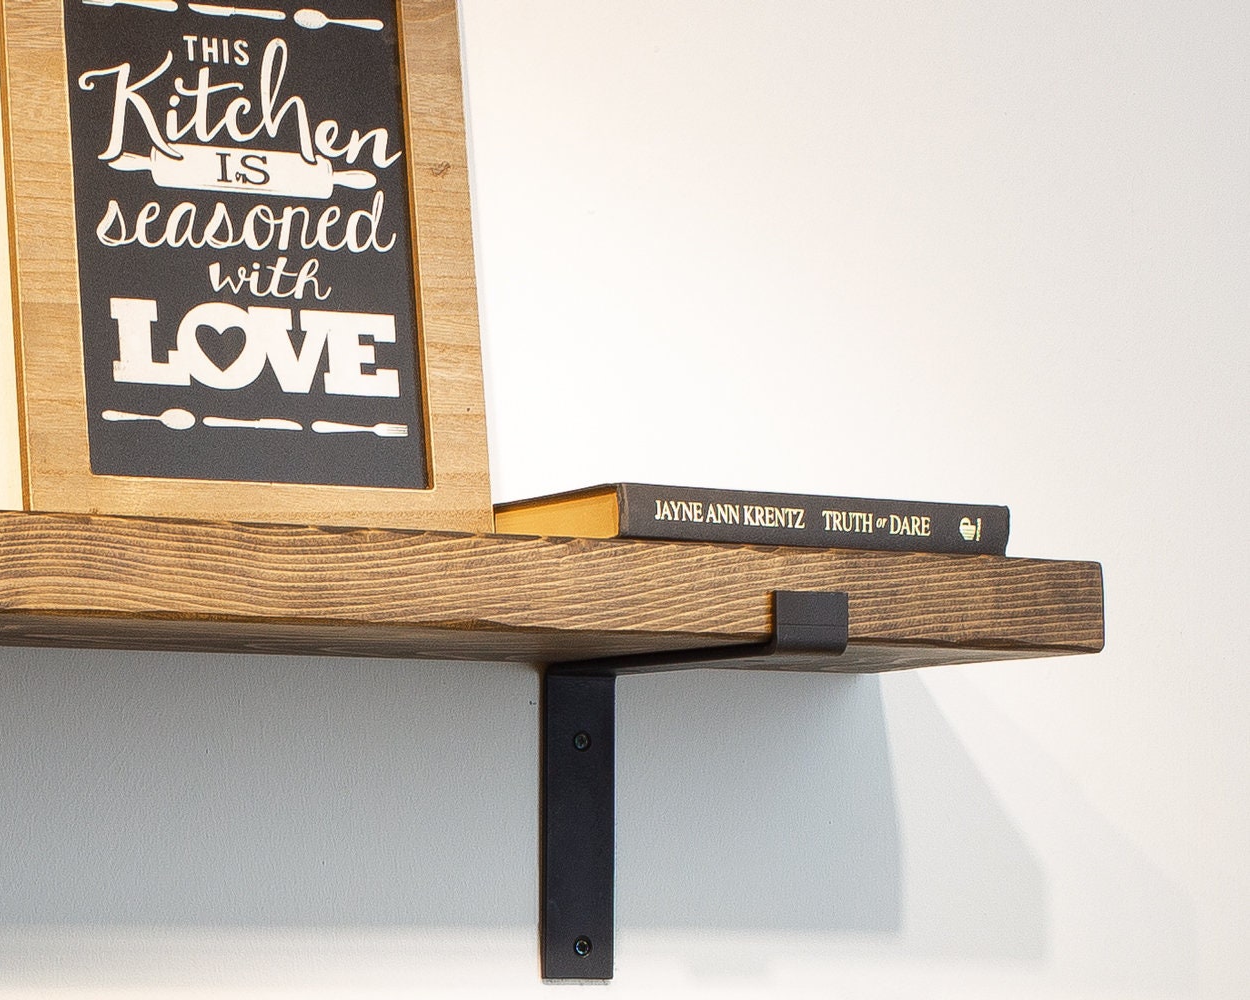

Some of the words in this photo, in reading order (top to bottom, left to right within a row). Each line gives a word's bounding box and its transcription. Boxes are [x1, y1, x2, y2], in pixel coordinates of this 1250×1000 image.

[183, 34, 250, 65] THIS
[78, 37, 402, 168] Kitchen
[215, 151, 271, 186] IS
[96, 190, 396, 253] seasoned
[208, 256, 331, 300] with
[109, 297, 400, 398] LOVE
[654, 499, 704, 523] JAYNE
[705, 503, 740, 525] ANN
[742, 505, 806, 530] KRENTZ
[821, 510, 874, 534] TRUTH
[875, 517, 888, 529] or
[889, 514, 931, 537] DARE
